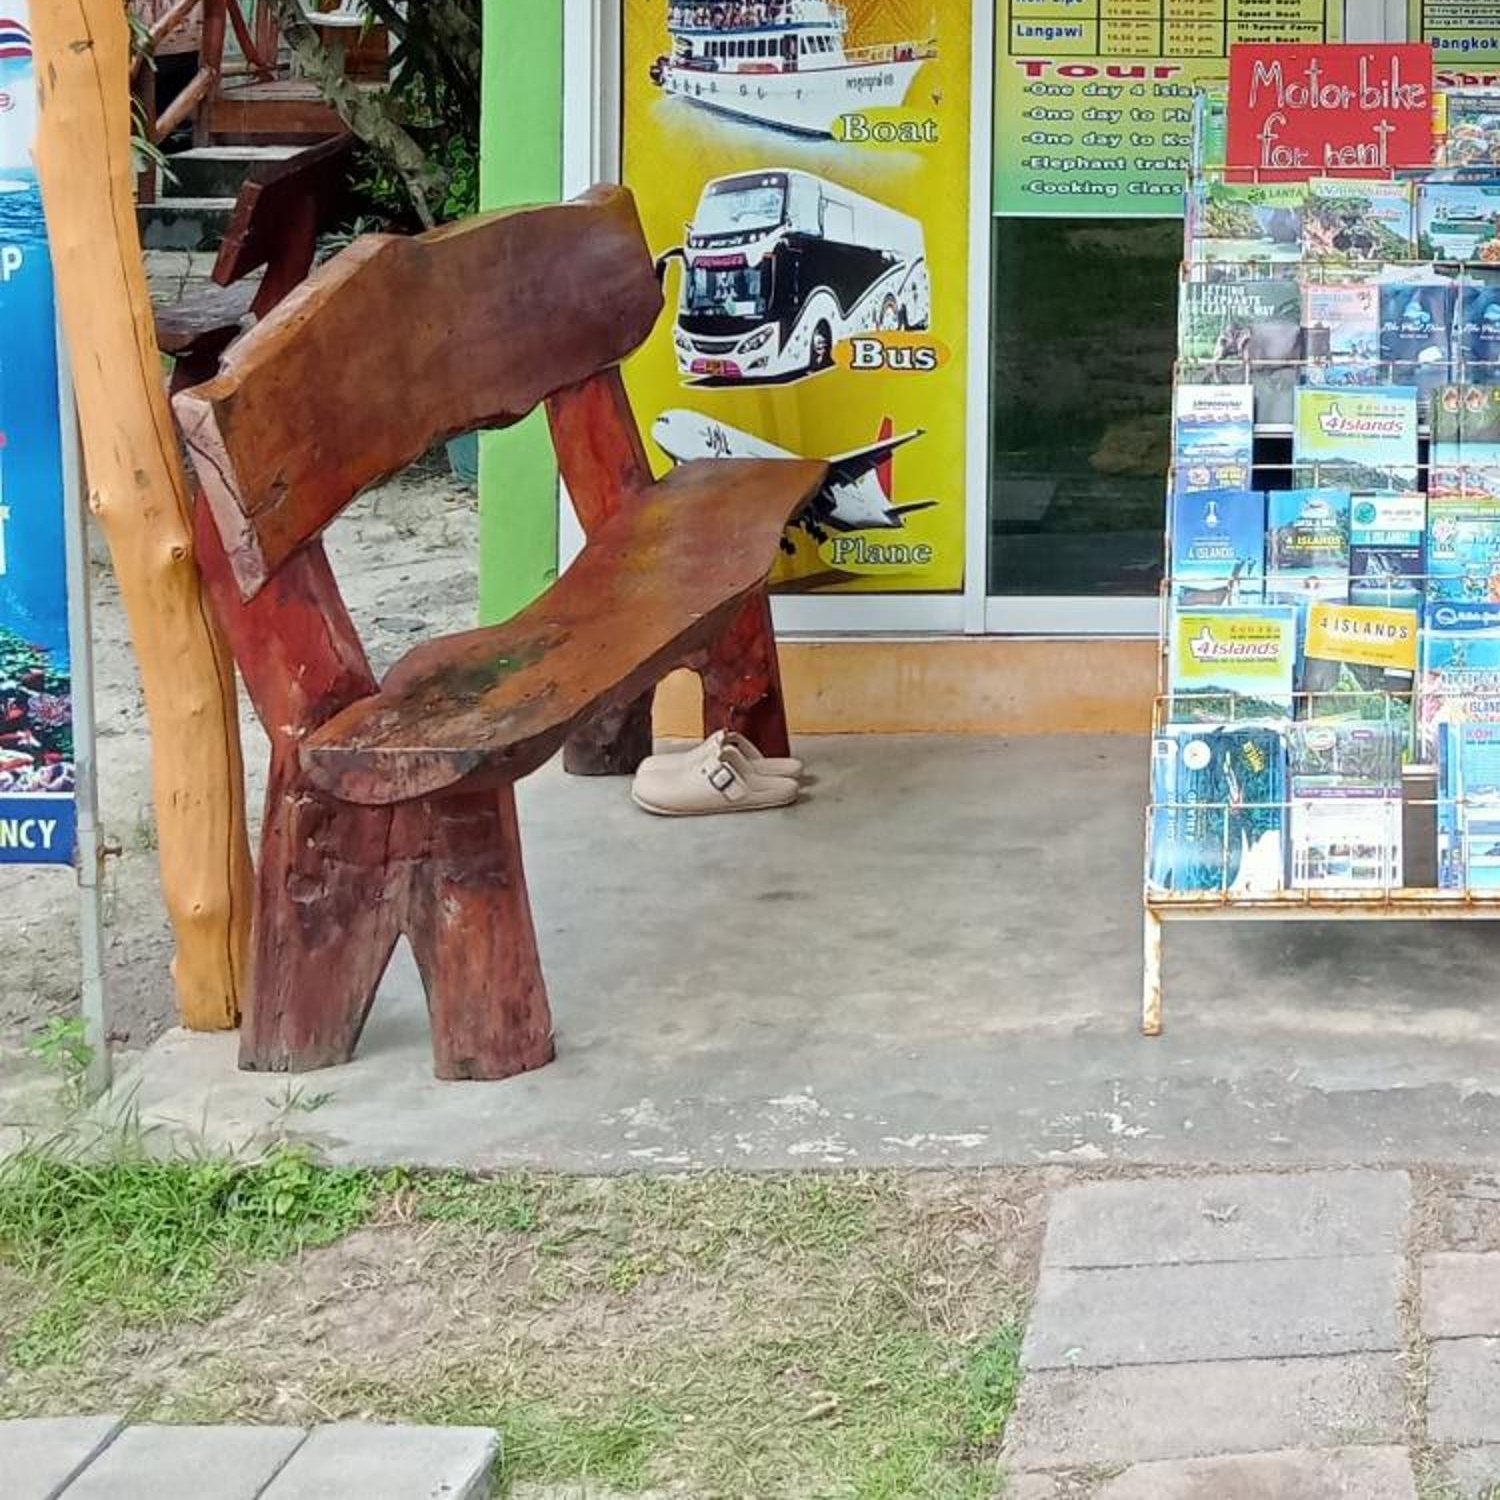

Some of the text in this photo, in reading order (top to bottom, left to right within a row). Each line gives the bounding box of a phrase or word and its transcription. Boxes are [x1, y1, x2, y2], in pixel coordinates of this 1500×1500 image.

[1017, 24, 1083, 41] Langawi
[1431, 36, 1499, 52] Bangkok
[1016, 60, 1182, 79] Tour
[1248, 52, 1429, 111] Motorbike
[1083, 84, 1122, 100] day
[1130, 83, 1146, 97] 4
[1082, 109, 1122, 124] day
[1131, 109, 1155, 122] to
[841, 113, 939, 143] Boat
[1082, 133, 1122, 149] day
[1131, 133, 1155, 146] to
[1256, 111, 1396, 171] for rent
[1128, 182, 1183, 195] Class
[850, 338, 937, 370] Bus
[831, 537, 932, 565] Plane
[1320, 617, 1410, 641] 4 ISLANDS
